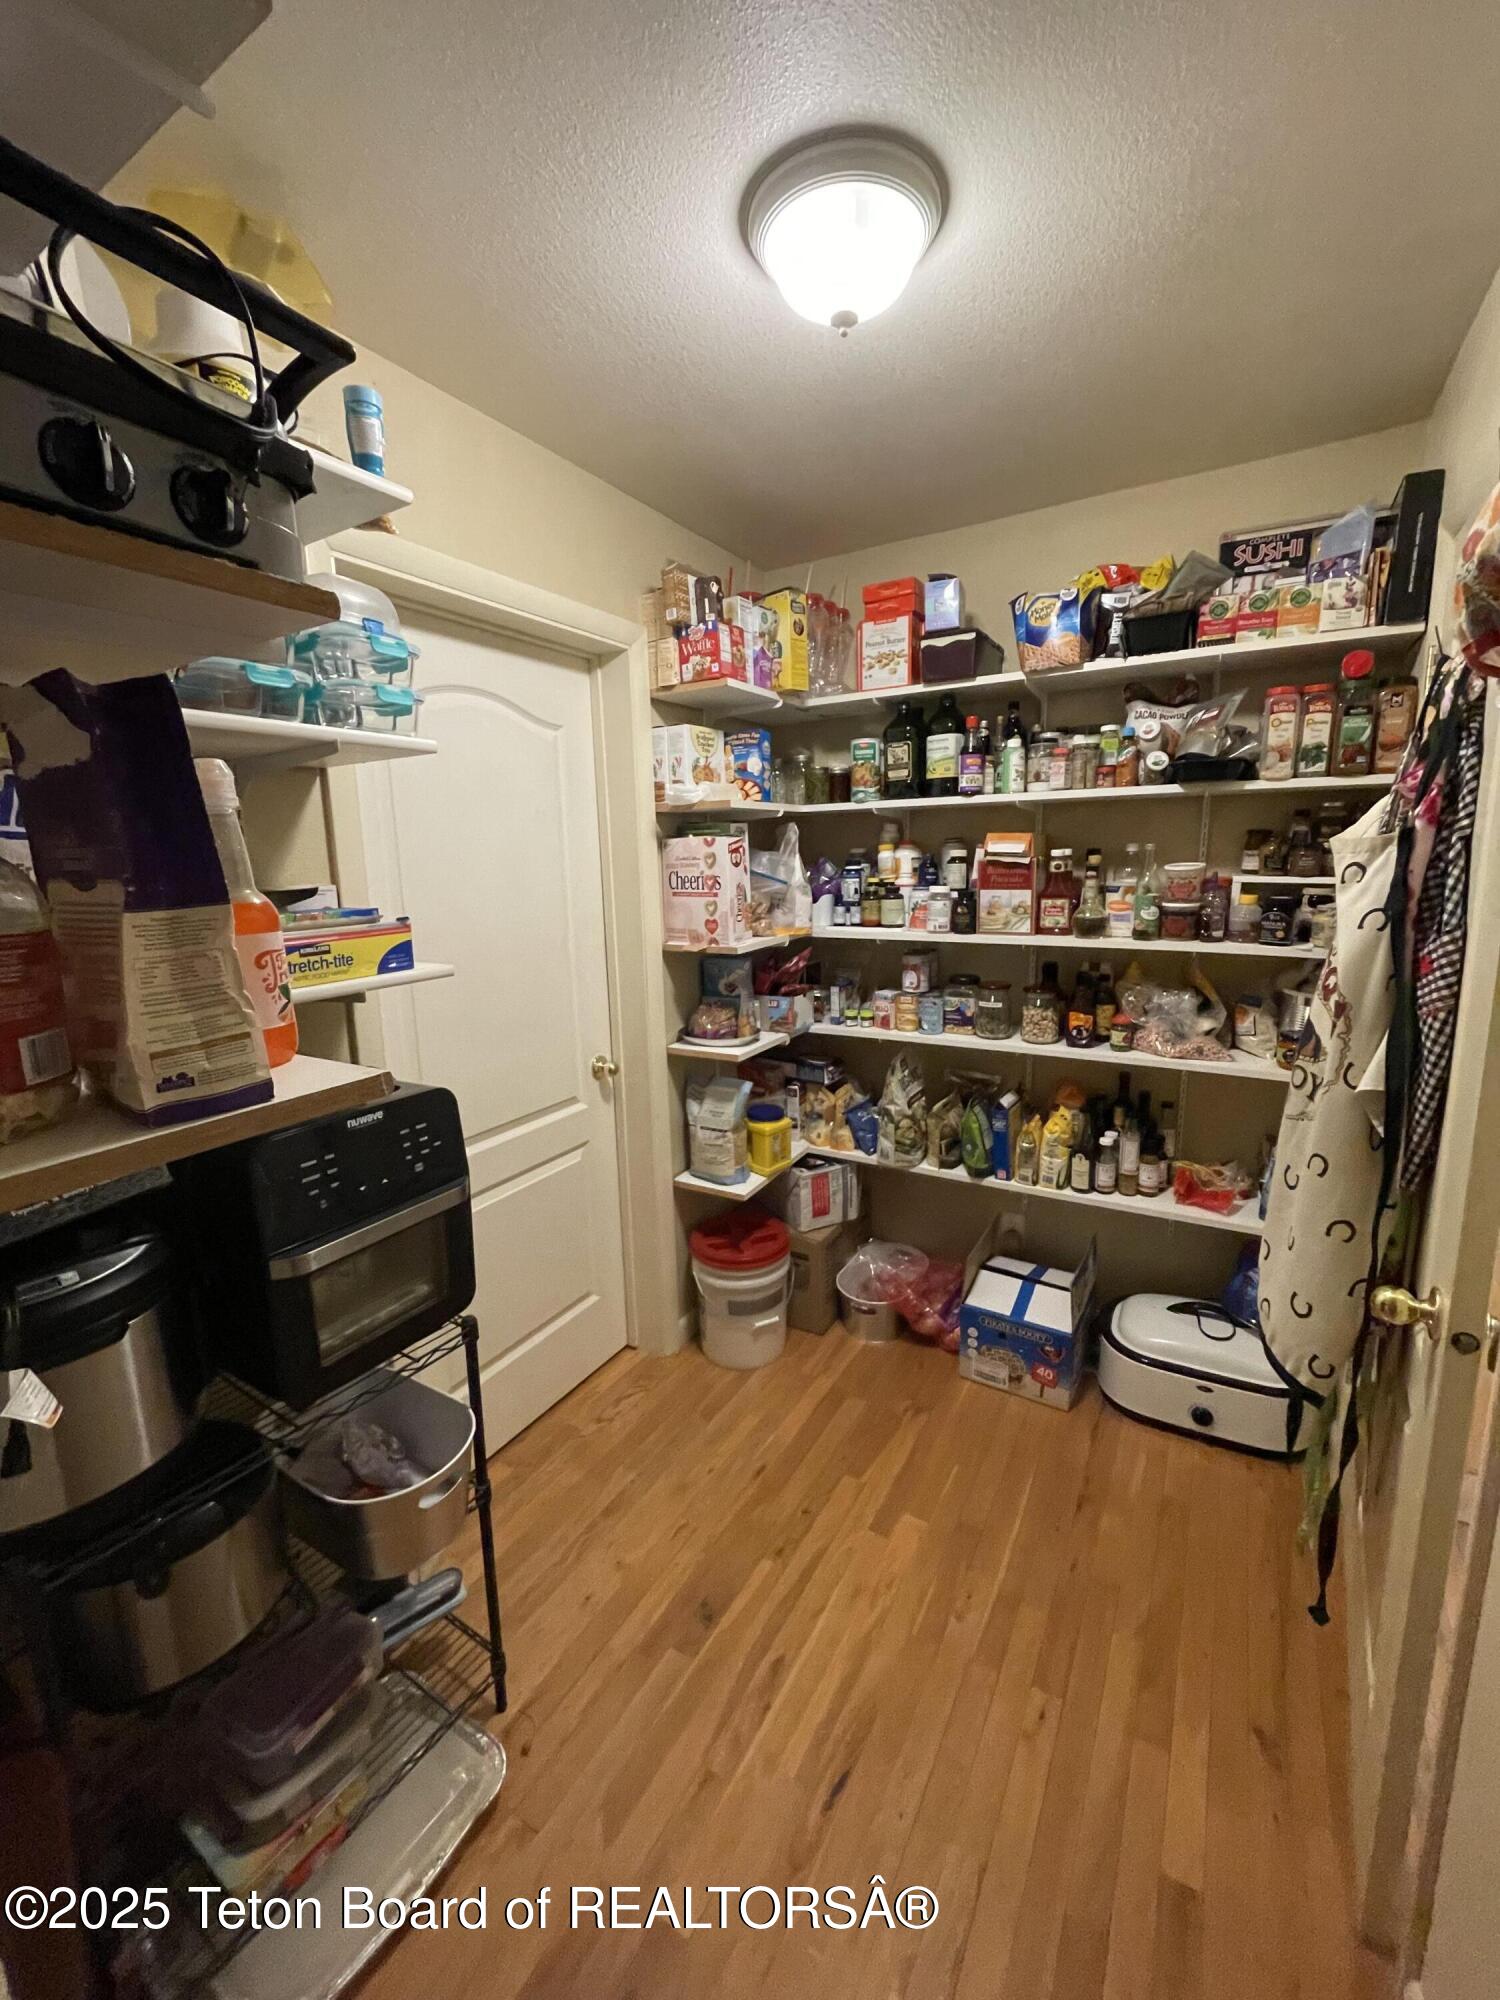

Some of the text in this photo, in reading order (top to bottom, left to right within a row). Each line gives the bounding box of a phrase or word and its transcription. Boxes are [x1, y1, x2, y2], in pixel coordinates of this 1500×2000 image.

[1250, 533, 1290, 546] COMPLETE
[1233, 538, 1304, 567] SUSHI
[1030, 602, 1057, 618] Honey
[681, 638, 715, 656] Waffle
[288, 953, 354, 975] tretch-tite
[347, 1110, 384, 1129] nuwave
[1037, 1367, 1053, 1380] 40
